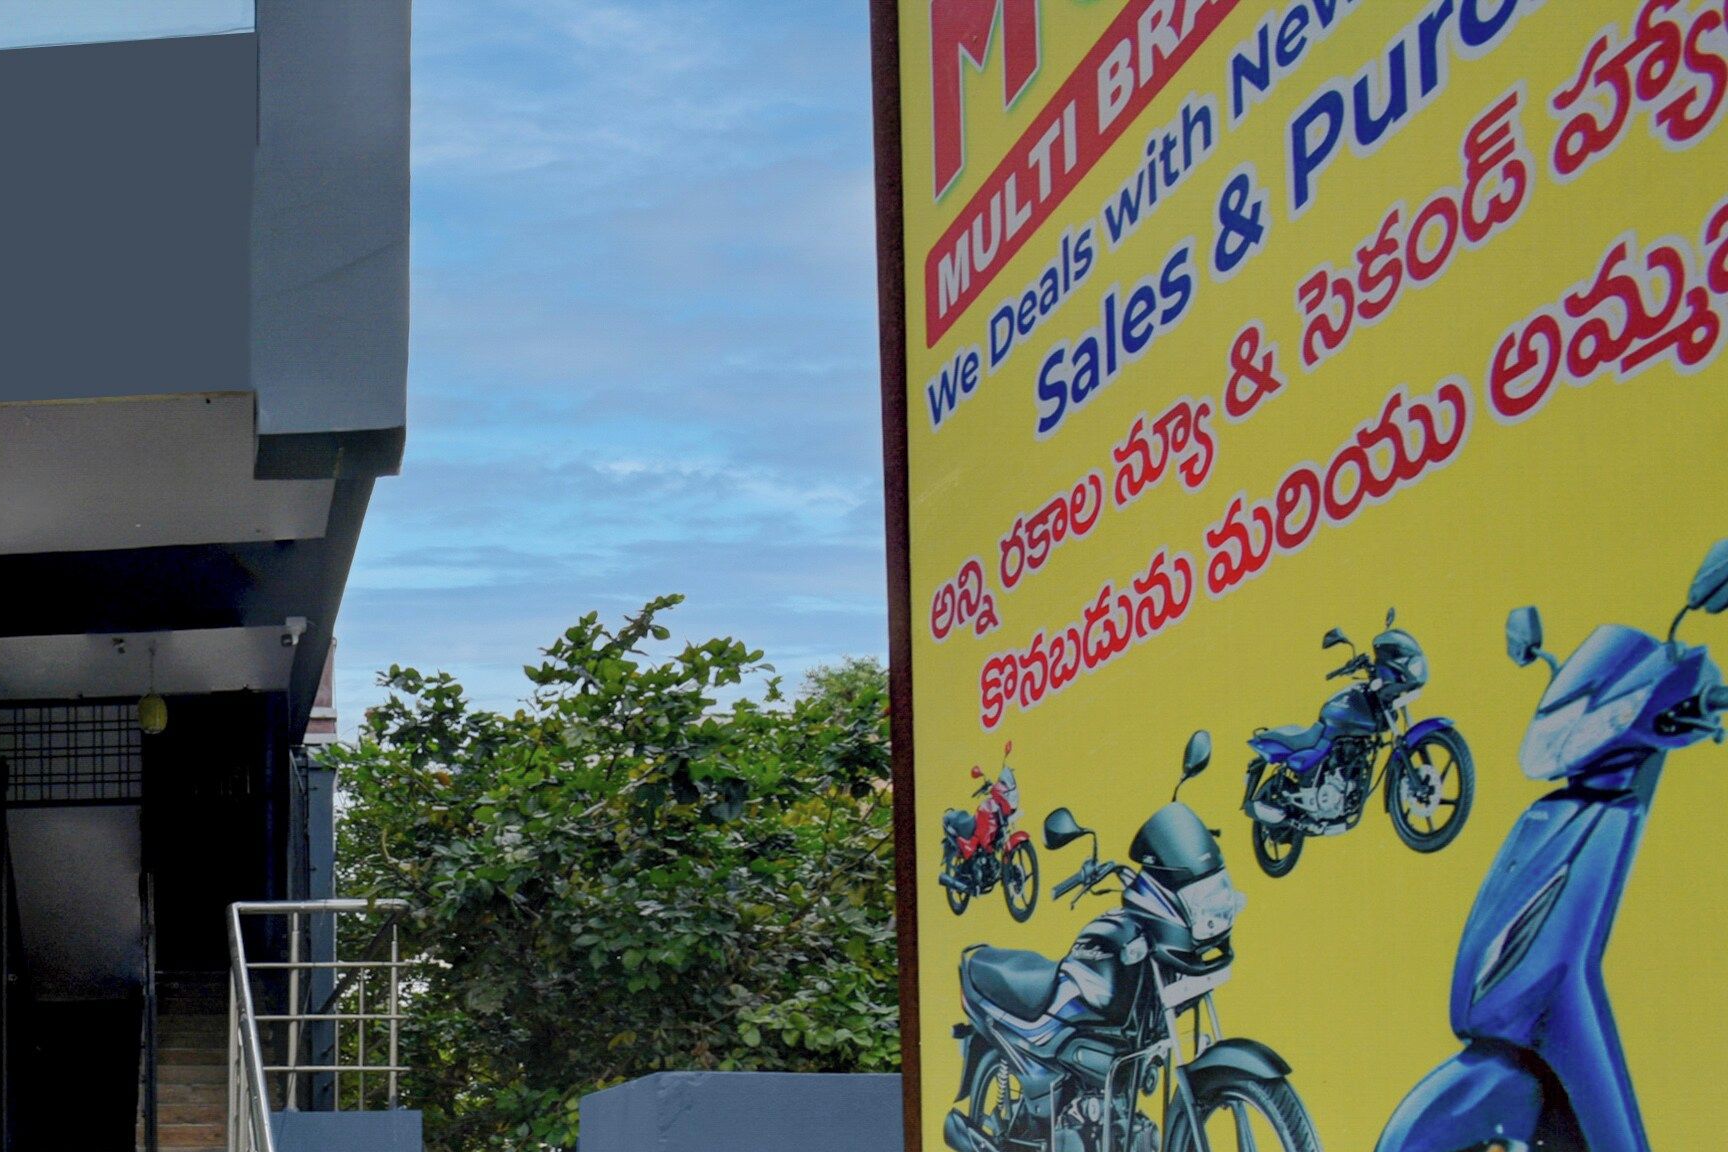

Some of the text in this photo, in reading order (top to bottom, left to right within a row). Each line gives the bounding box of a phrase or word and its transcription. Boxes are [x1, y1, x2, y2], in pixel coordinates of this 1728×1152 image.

[927, 352, 980, 426] We
[989, 228, 1094, 368] Deals
[1104, 103, 1212, 243] with
[931, 560, 999, 639] అన్ని
[1000, 473, 1102, 589] రకాల
[1114, 401, 1215, 506] న్యూ
[1226, 326, 1283, 417] &
[1298, 91, 1527, 367] సెకండ్
[938, 98, 1077, 319] MULTI
[1038, 247, 1192, 433] Sales
[1215, 173, 1265, 272] &
[981, 551, 1192, 728] కొనబడును
[1207, 384, 1466, 594] మరియు
